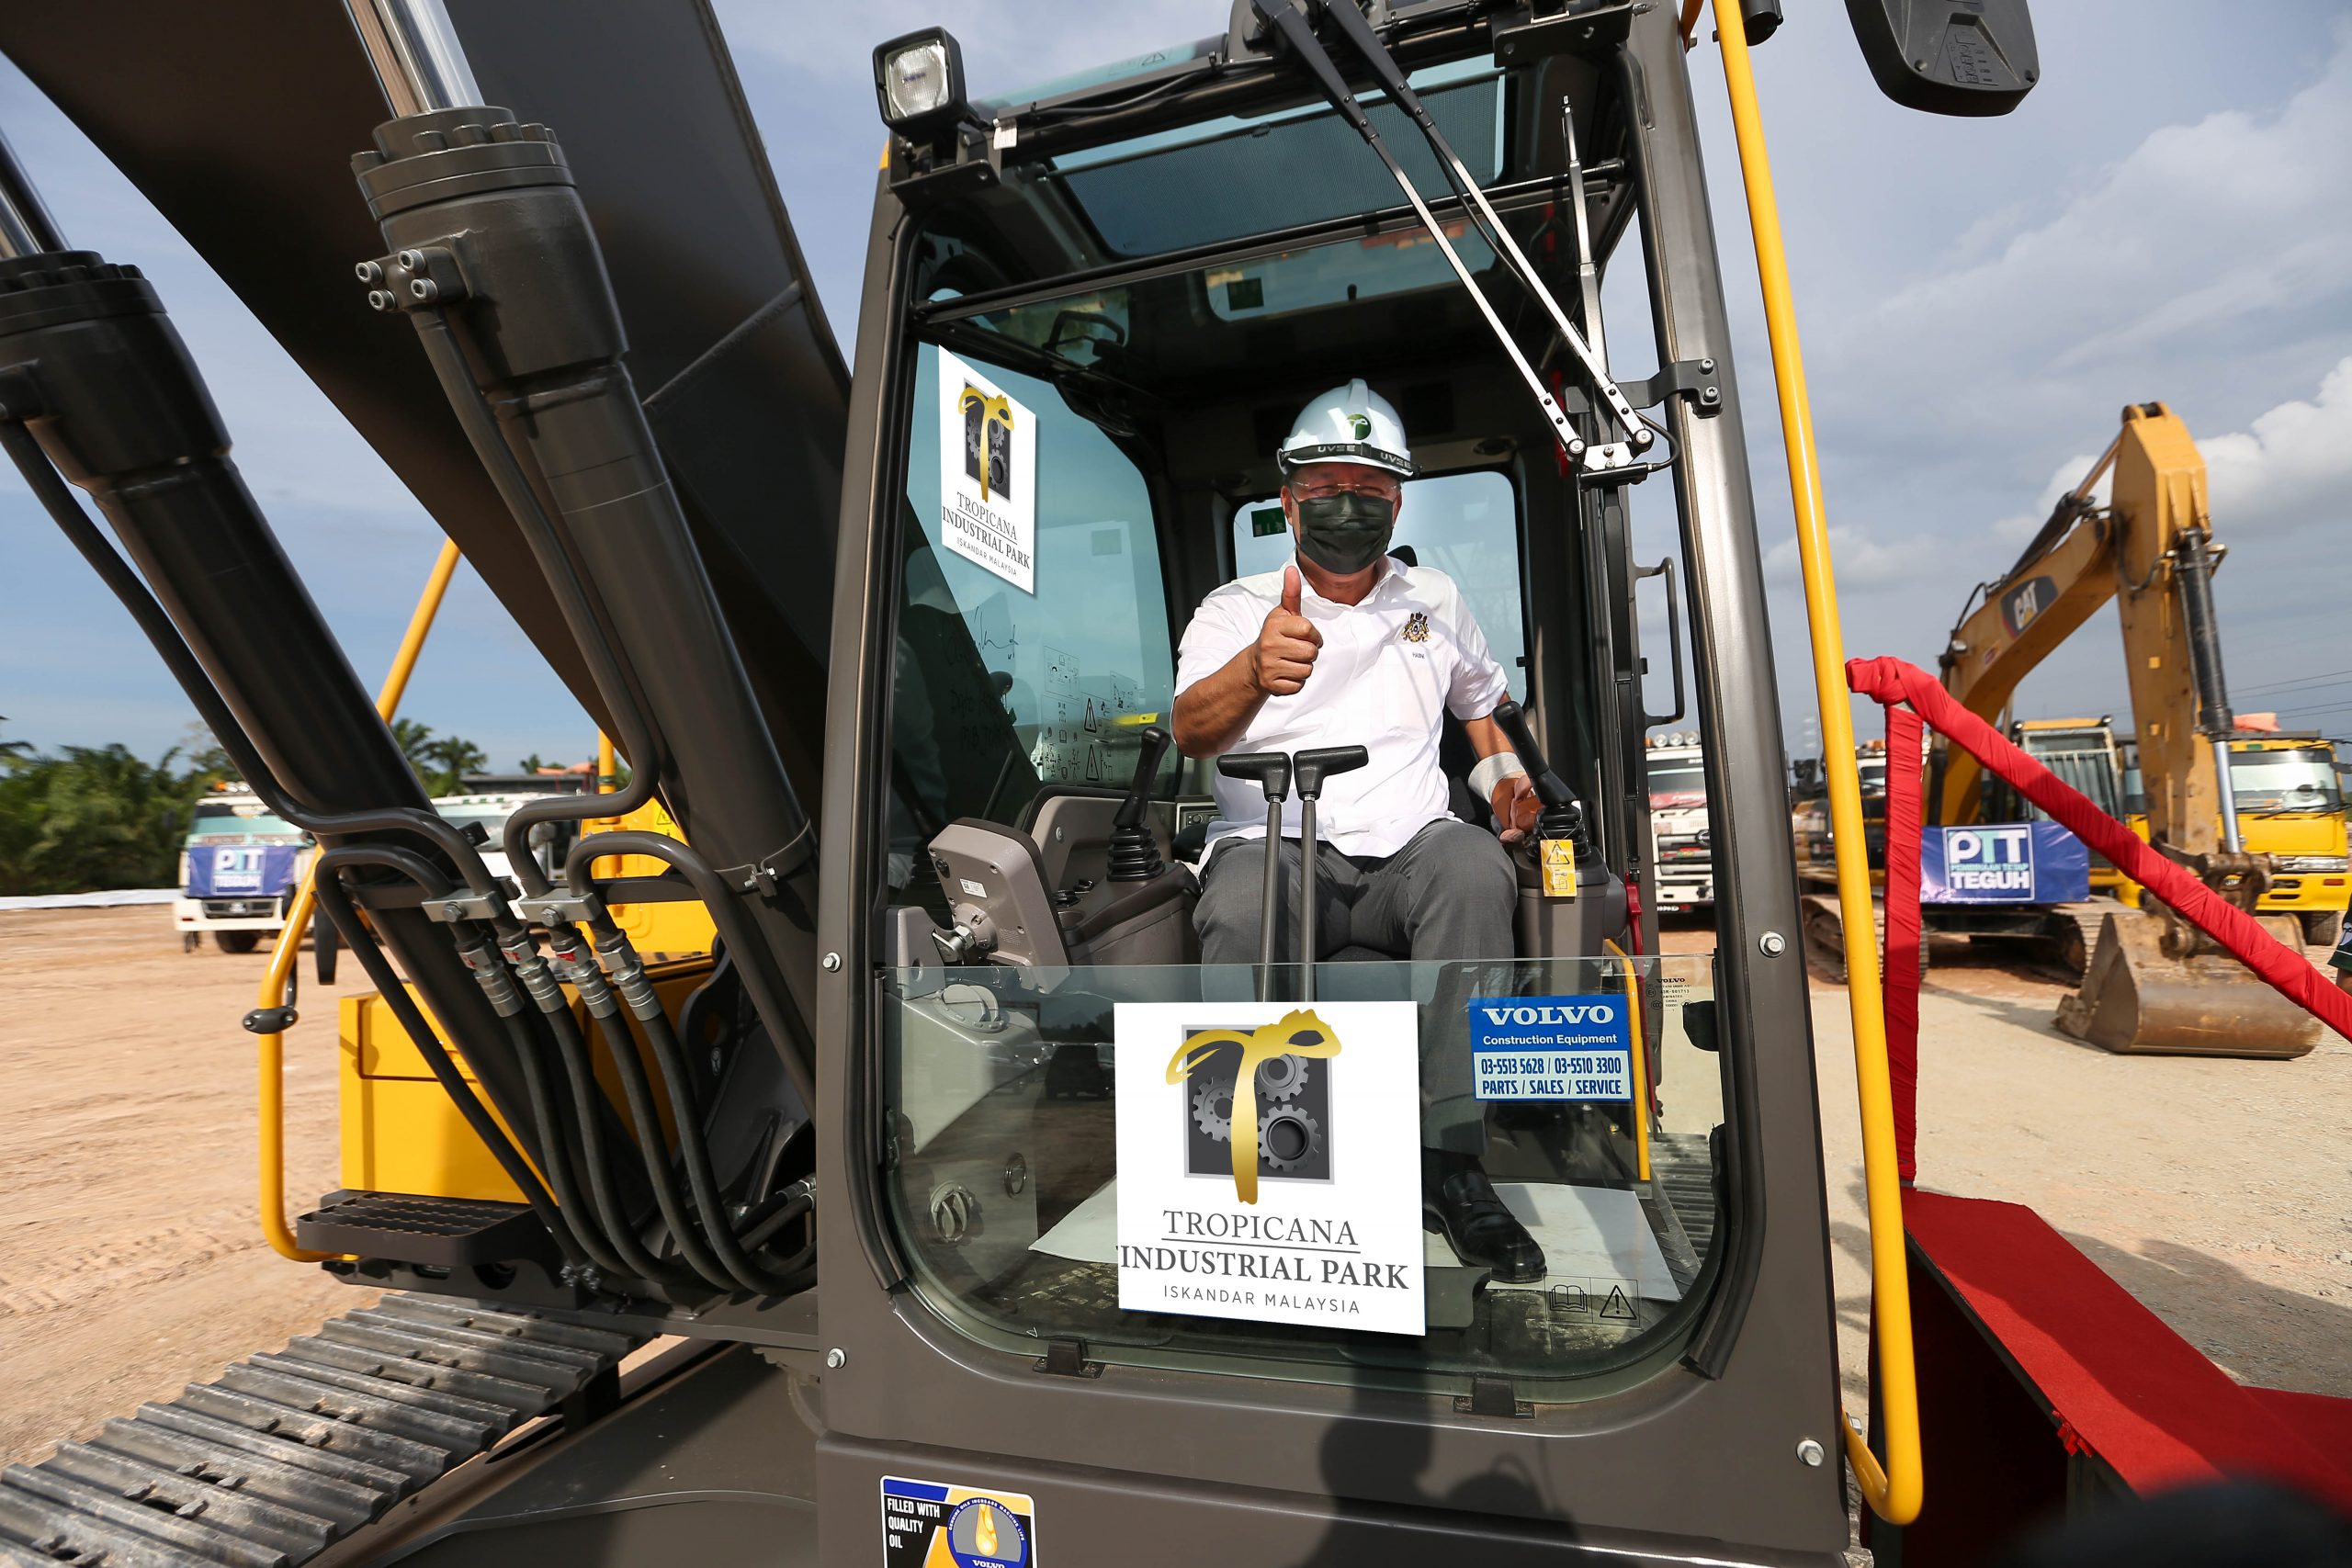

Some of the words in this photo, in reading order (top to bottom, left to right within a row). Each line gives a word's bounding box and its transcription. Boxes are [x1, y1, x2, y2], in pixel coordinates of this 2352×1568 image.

[956, 491, 1018, 541] TROPICANA
[942, 505, 1004, 555] INDUSTRIAL
[1005, 542, 1031, 570] PARK
[956, 536, 988, 561] ISKANDAR
[989, 555, 1017, 577] MALAYSIA
[2014, 580, 2039, 631] CAT
[1949, 829, 2028, 863] PTT
[1950, 871, 2030, 889] TEGUH
[1482, 1005, 1614, 1026] VOLVO
[1483, 1035, 1554, 1045] Construction
[1556, 1033, 1618, 1045] Equipment
[1481, 1058, 1518, 1075] 03-5513
[1520, 1058, 1544, 1075] 5628
[1555, 1057, 1593, 1074] 03-5510
[1596, 1057, 1622, 1074] 3300
[1482, 1080, 1519, 1095] PARTS
[1529, 1079, 1565, 1095] SALES
[1576, 1079, 1623, 1095] SERVICE
[1163, 1210, 1359, 1246] TROPICANA
[1120, 1245, 1312, 1282] INDUSTRIAL
[1321, 1259, 1409, 1290] PARK
[1164, 1284, 1255, 1305] ISKANDAR
[1265, 1293, 1360, 1314] MALAYSIA
[887, 1497, 915, 1515] FILLED
[916, 1501, 941, 1518] WITH
[888, 1516, 924, 1534] QUALITY
[888, 1533, 903, 1549] OIL
[972, 1559, 1005, 1568] VOLVO
